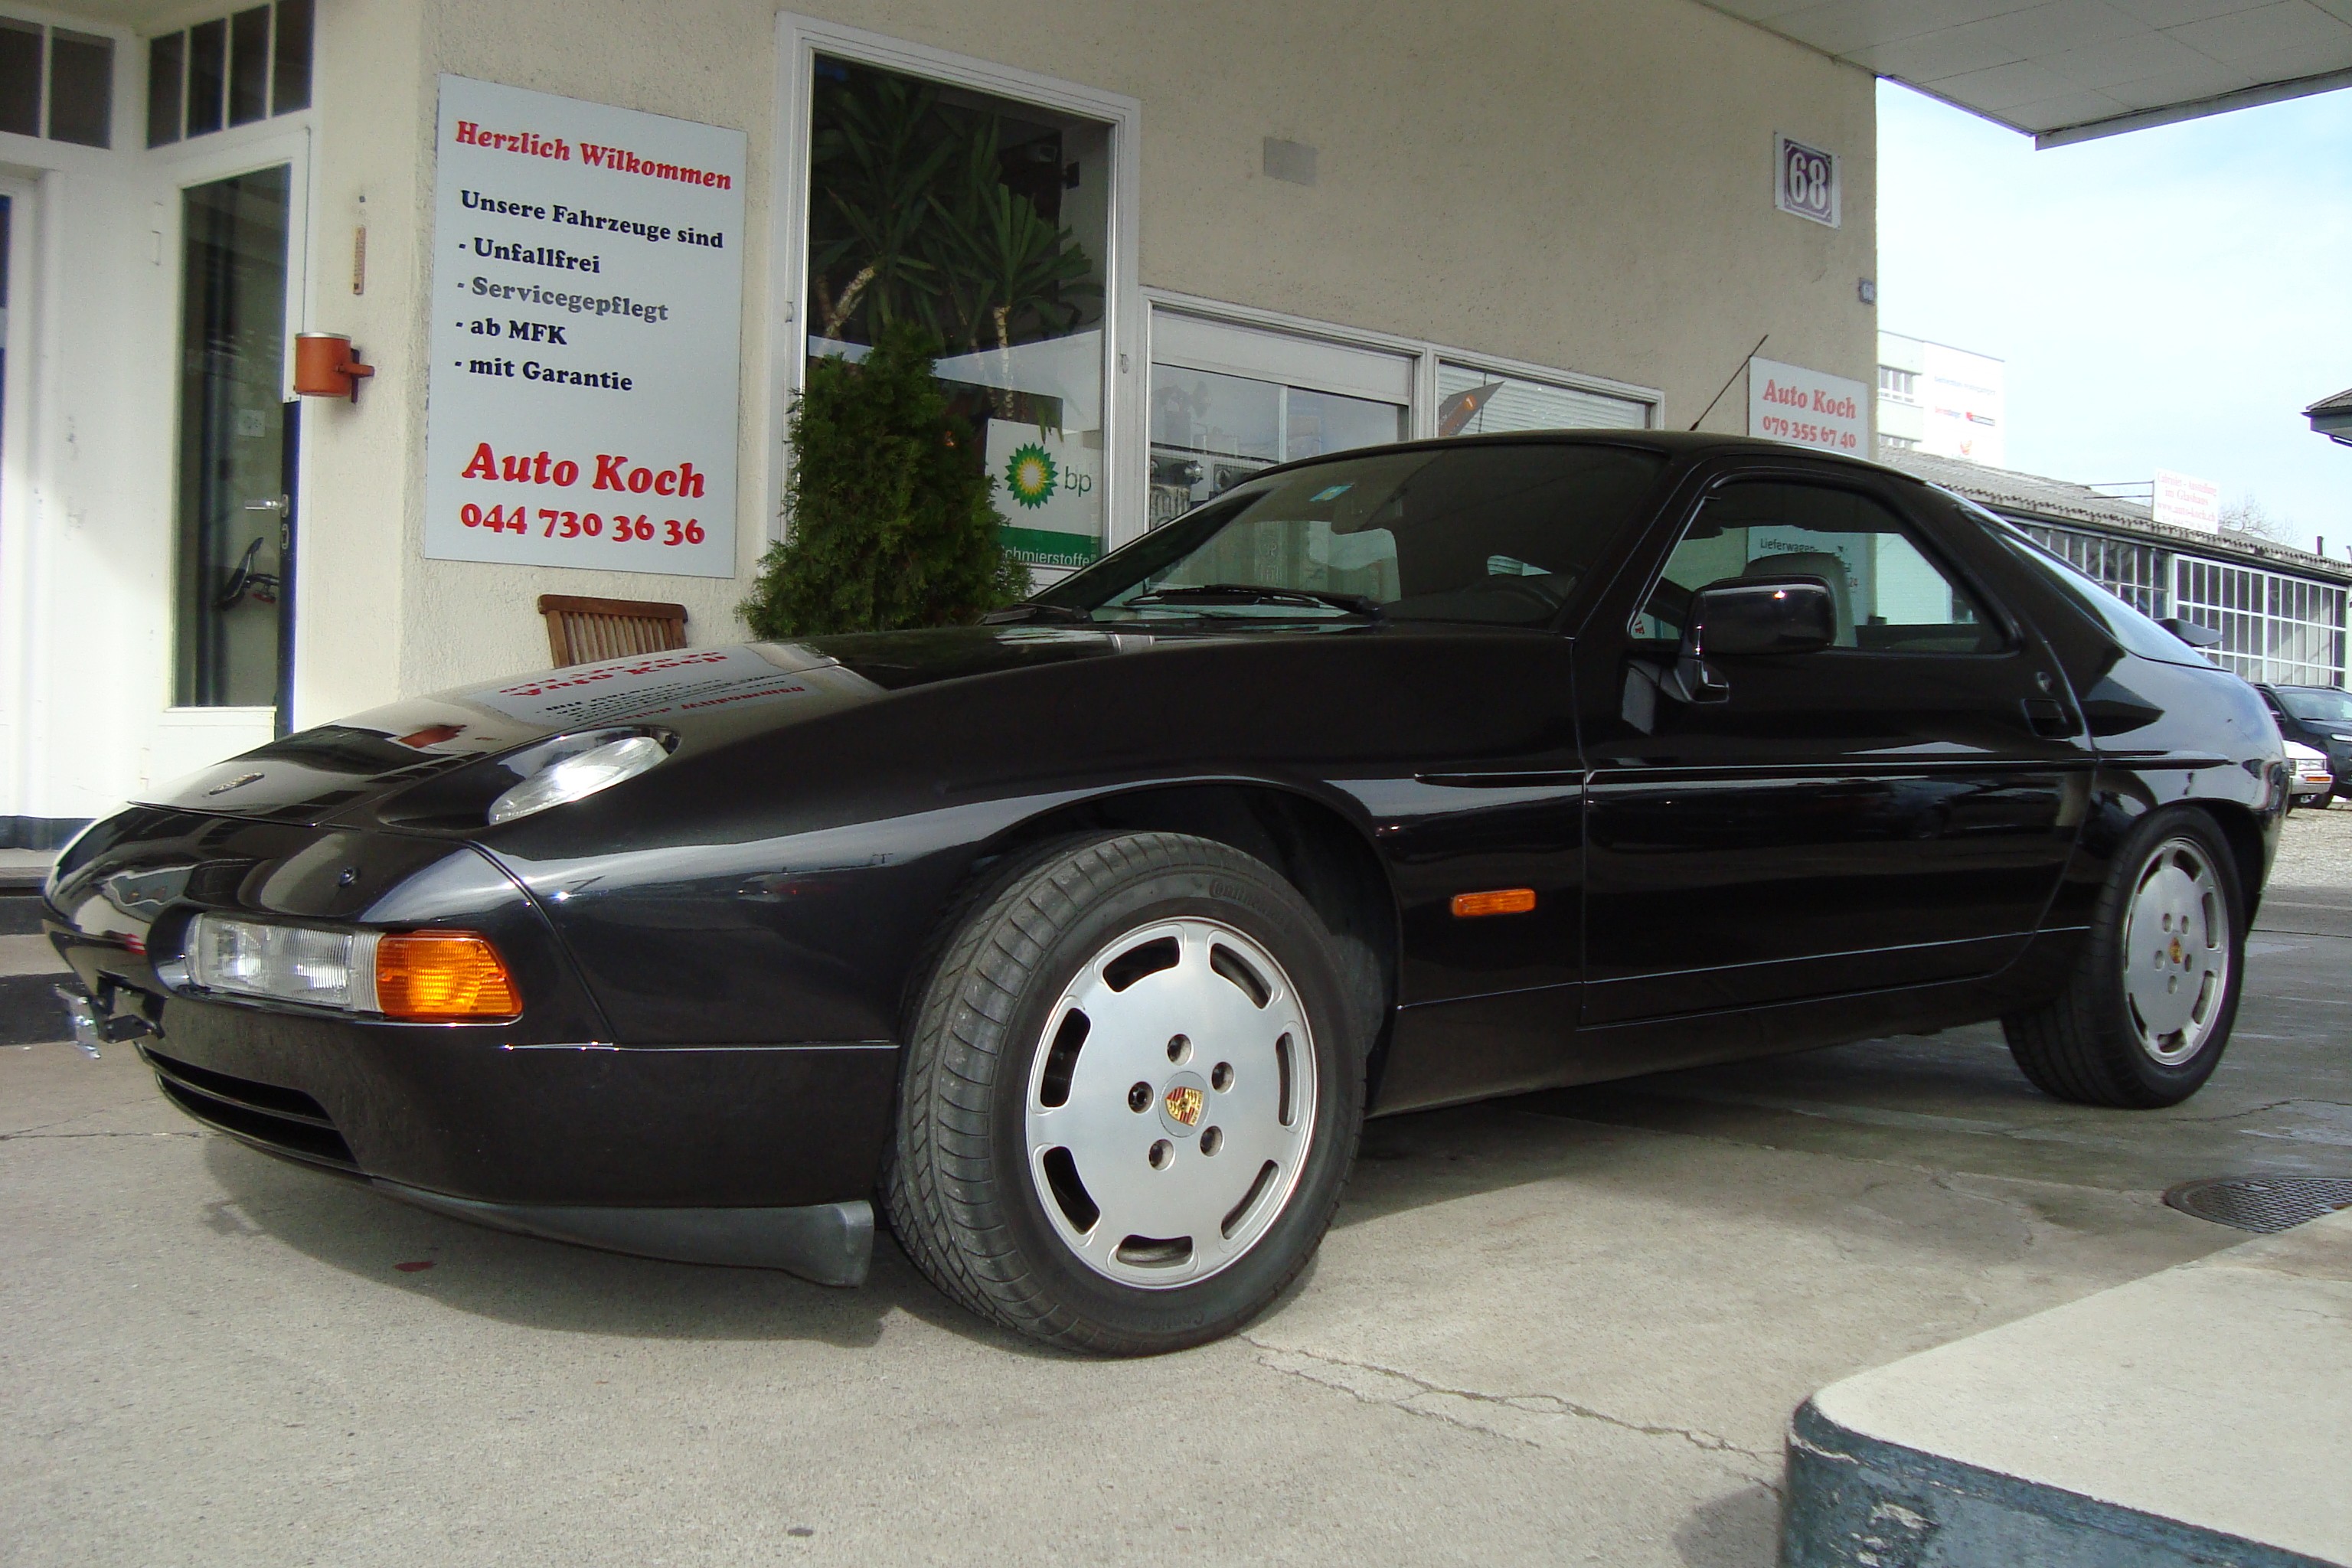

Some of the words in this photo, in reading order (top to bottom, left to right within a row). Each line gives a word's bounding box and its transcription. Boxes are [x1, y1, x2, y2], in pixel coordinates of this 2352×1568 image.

[456, 121, 570, 161] Herzlich
[580, 143, 731, 190] Wilkommen
[1790, 152, 1826, 210] 68
[460, 189, 546, 220] Unsere
[551, 204, 671, 243] Fahrzeuge
[676, 227, 724, 249] sind
[474, 237, 601, 274] Unfallfrei
[472, 276, 669, 324] Servicegepflegt
[470, 317, 501, 337] ab
[508, 319, 568, 345] MFK
[469, 357, 515, 378] mit
[521, 361, 633, 391] Garantie
[1763, 378, 1808, 408] Auto
[1812, 389, 1856, 419] Koch
[1762, 415, 1788, 436] 079
[1792, 421, 1818, 442] 355
[1821, 426, 1838, 446] 67
[1840, 430, 1857, 449] 40
[461, 442, 580, 488] Auto
[592, 454, 705, 498] Koch
[1064, 466, 1092, 497] bp
[460, 503, 528, 535] 044
[537, 508, 603, 539] 730
[612, 514, 655, 543] 36
[663, 518, 705, 547] 36
[1003, 544, 1090, 567] chmierstoffe
